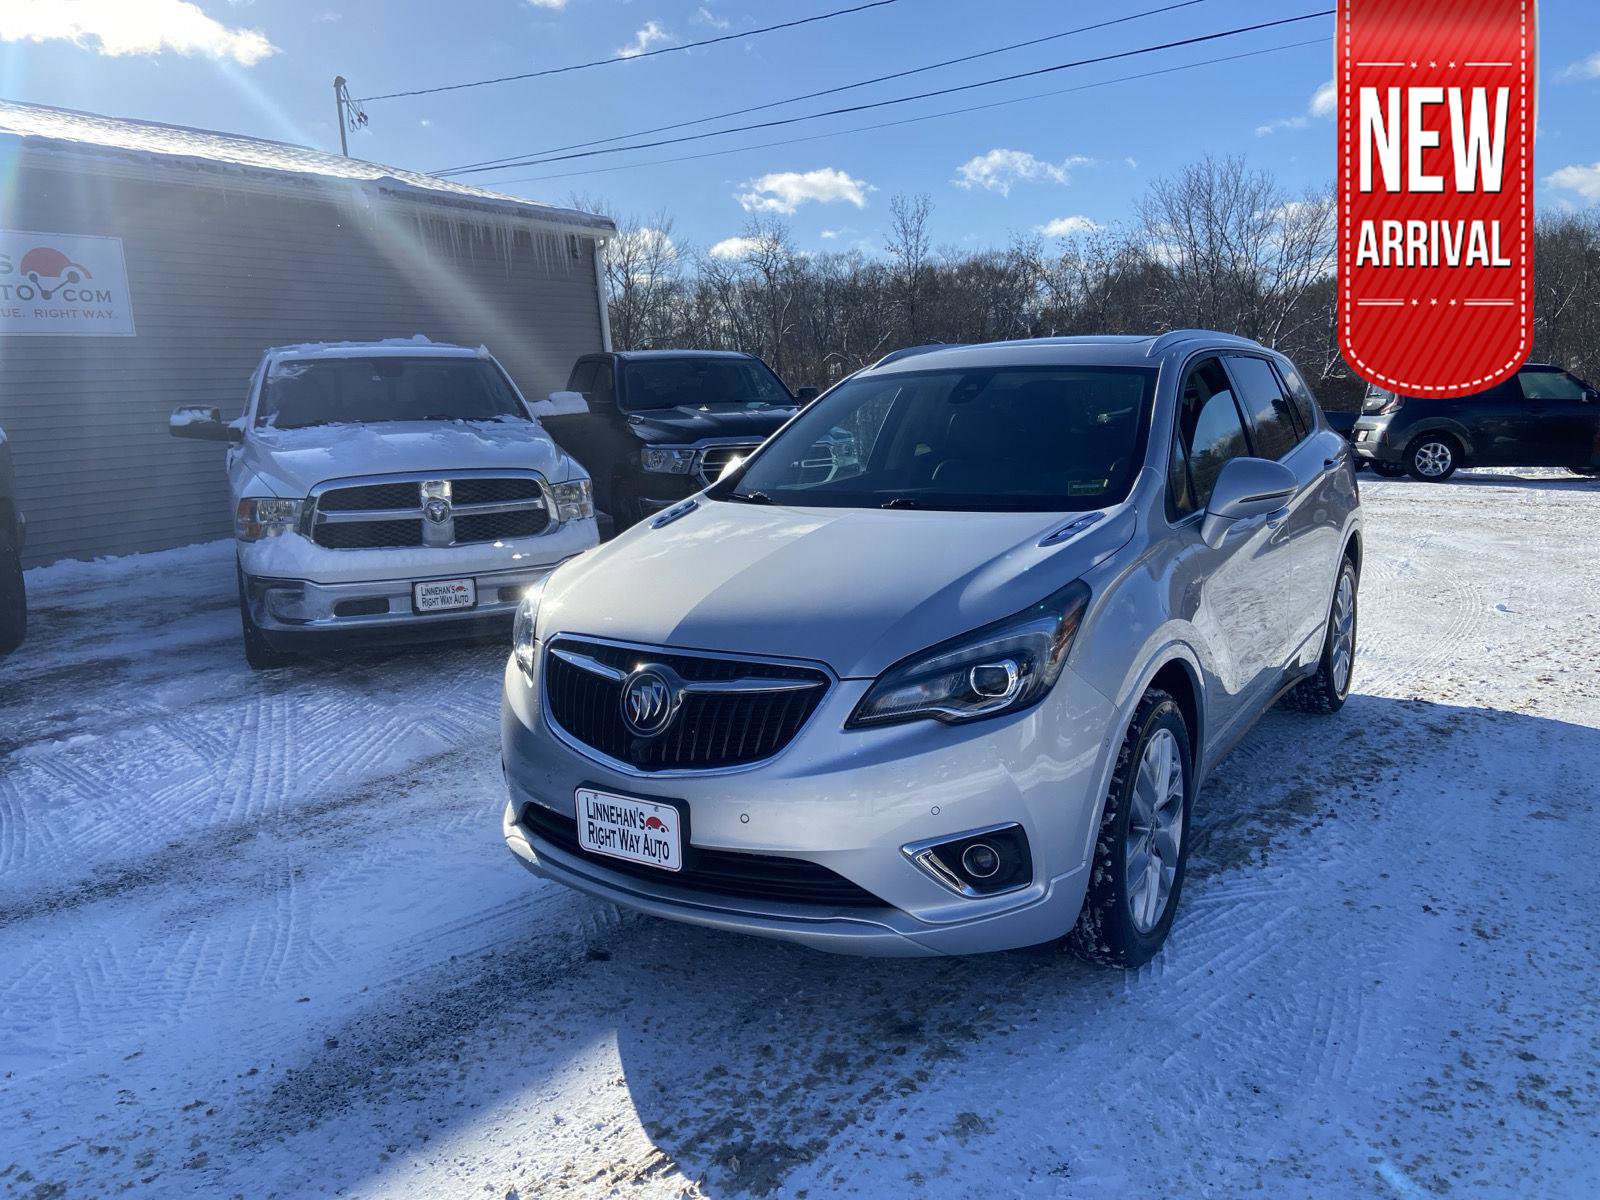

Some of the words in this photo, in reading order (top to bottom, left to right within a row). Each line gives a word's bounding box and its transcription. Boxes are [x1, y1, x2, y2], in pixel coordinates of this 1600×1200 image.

[34, 308, 79, 319] RIGHT
[421, 585, 455, 597] LINNEHAN'S
[421, 597, 439, 607] RIGHT
[440, 595, 453, 606] WAY
[454, 594, 469, 605] AUTO
[586, 797, 645, 830] LINNEHAN'S
[588, 821, 616, 848] RIGHT
[618, 828, 641, 854] WAY
[643, 834, 670, 860] AUTO
